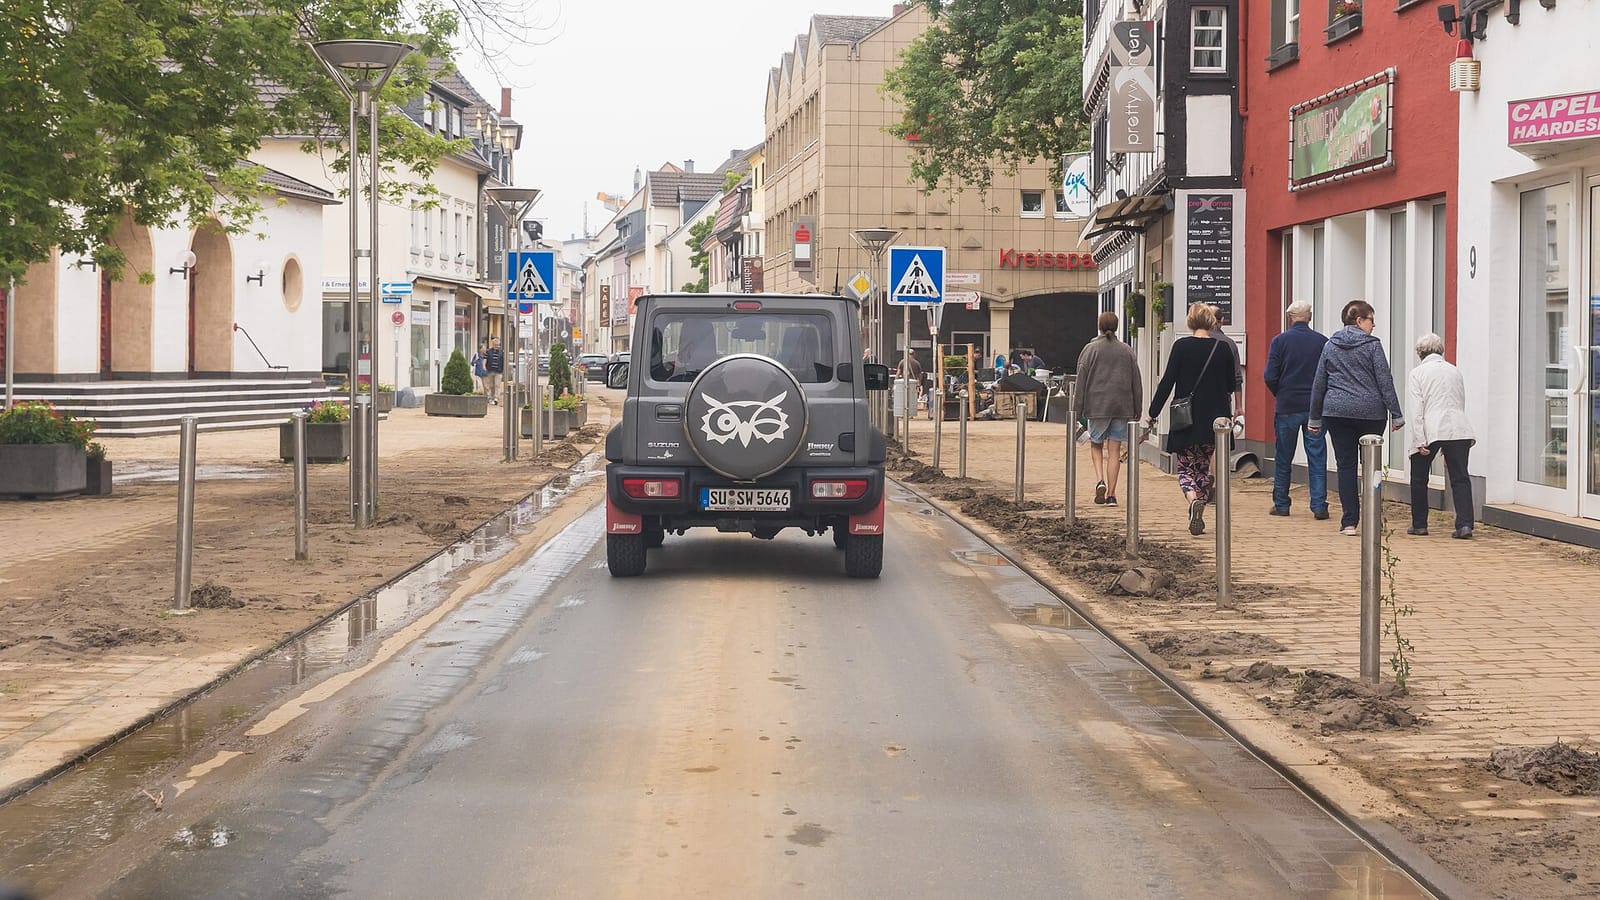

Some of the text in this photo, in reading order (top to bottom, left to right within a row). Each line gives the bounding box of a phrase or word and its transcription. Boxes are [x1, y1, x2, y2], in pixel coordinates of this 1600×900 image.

[1470, 245, 1477, 279] 9
[710, 491, 789, 506] SU SW 5646
